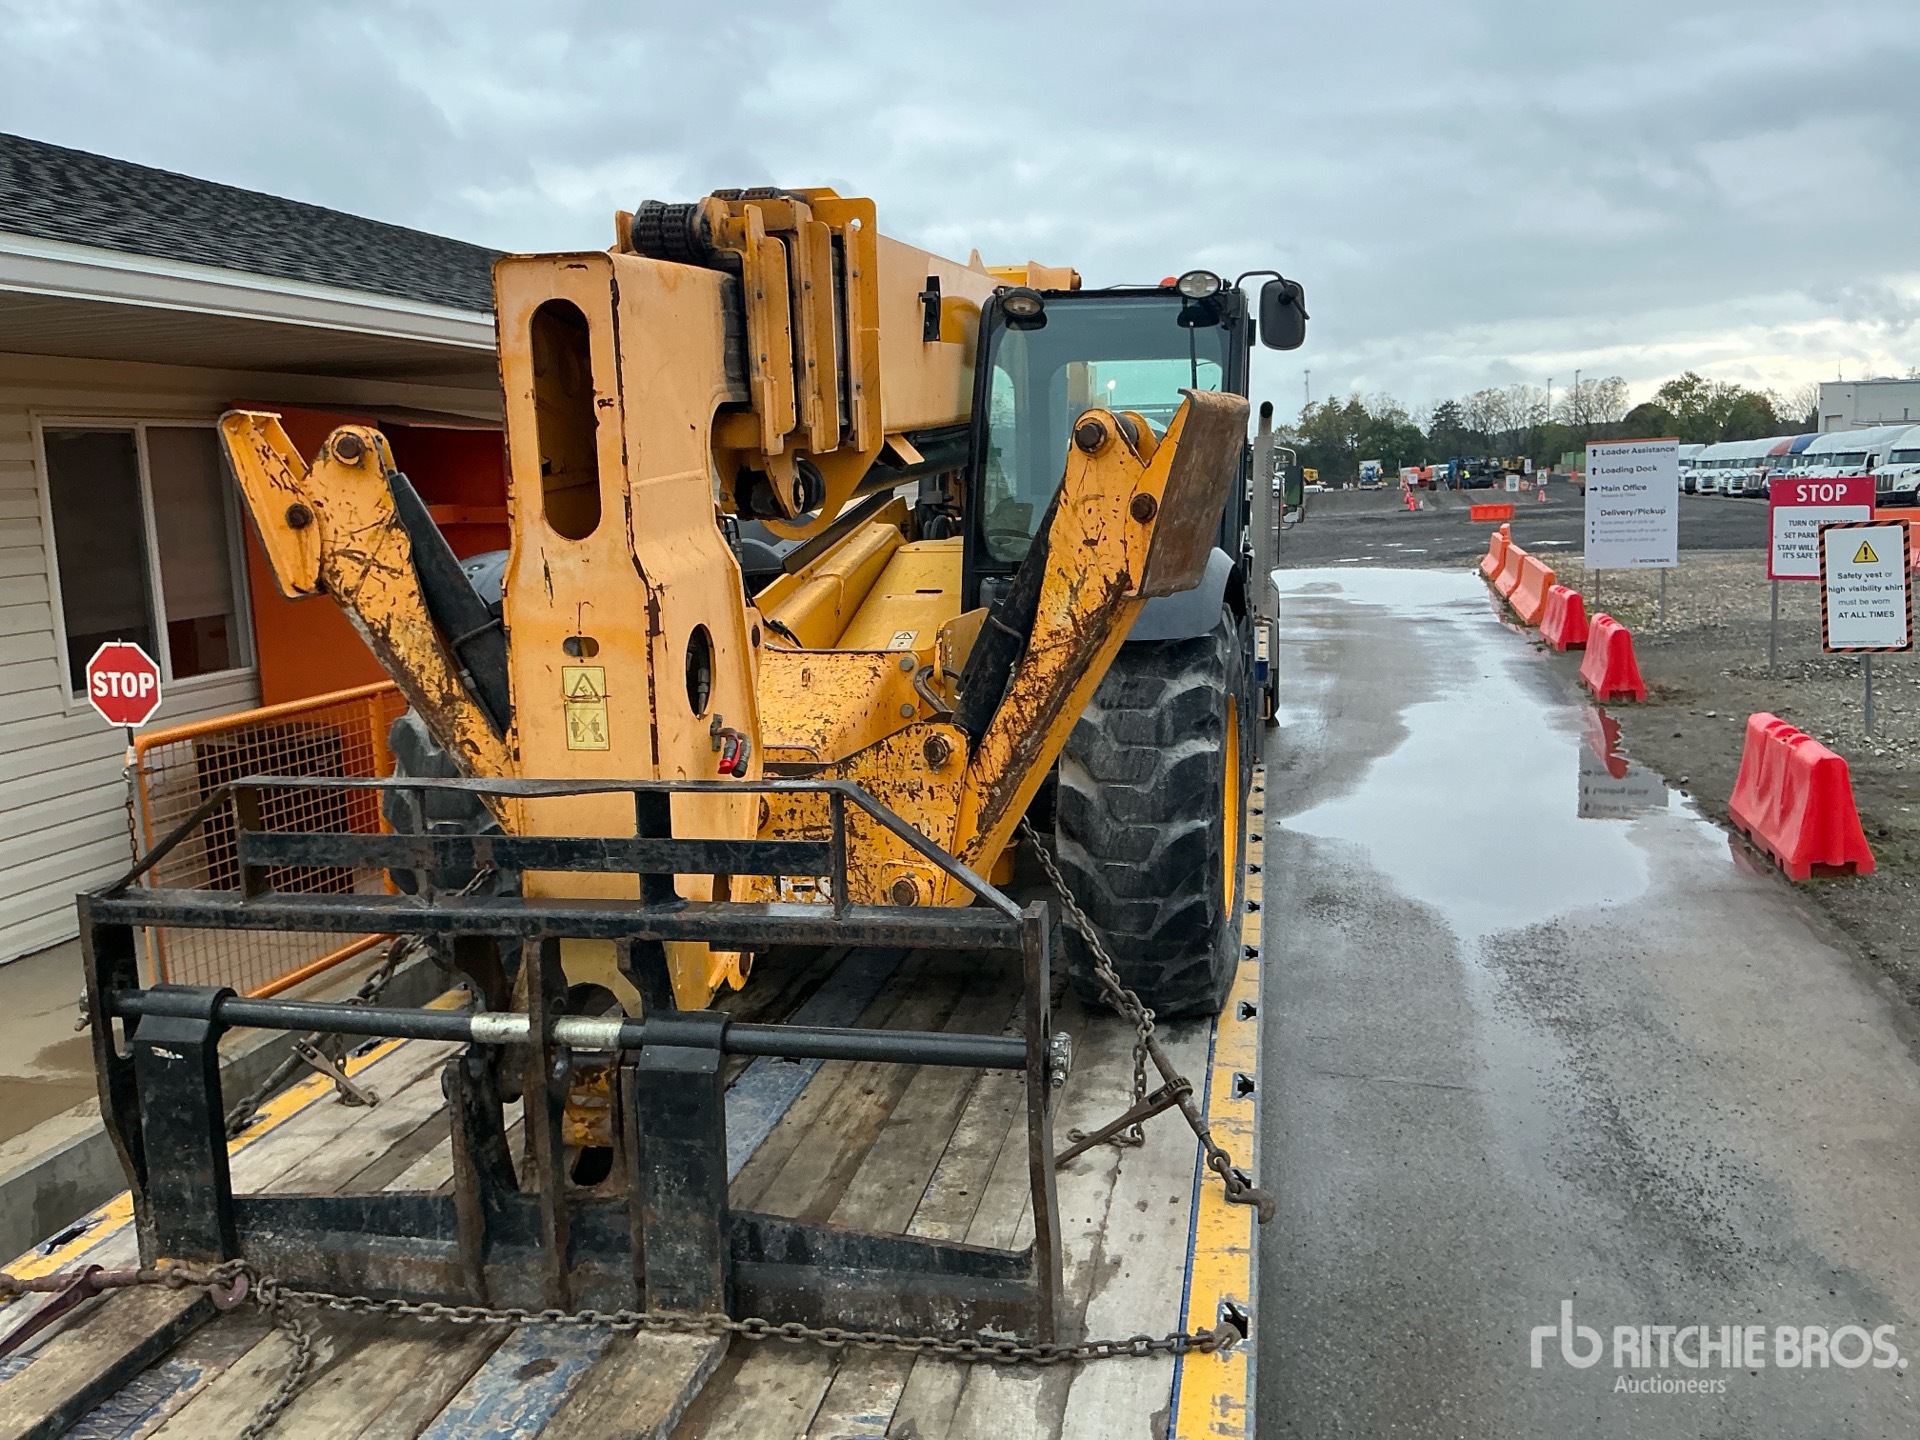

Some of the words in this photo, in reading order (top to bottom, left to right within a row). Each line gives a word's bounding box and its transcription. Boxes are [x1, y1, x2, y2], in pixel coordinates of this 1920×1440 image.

[1601, 448, 1629, 456] Loader
[1631, 446, 1675, 454] Assistance
[1601, 466, 1634, 474] Loading
[1796, 483, 1848, 502] STOP
[1600, 507, 1666, 517] Delivery/Pickup
[1837, 572, 1862, 580] Safety
[1828, 586, 1846, 594] high
[1869, 610, 1895, 618] TIMES
[92, 670, 155, 698] STOP
